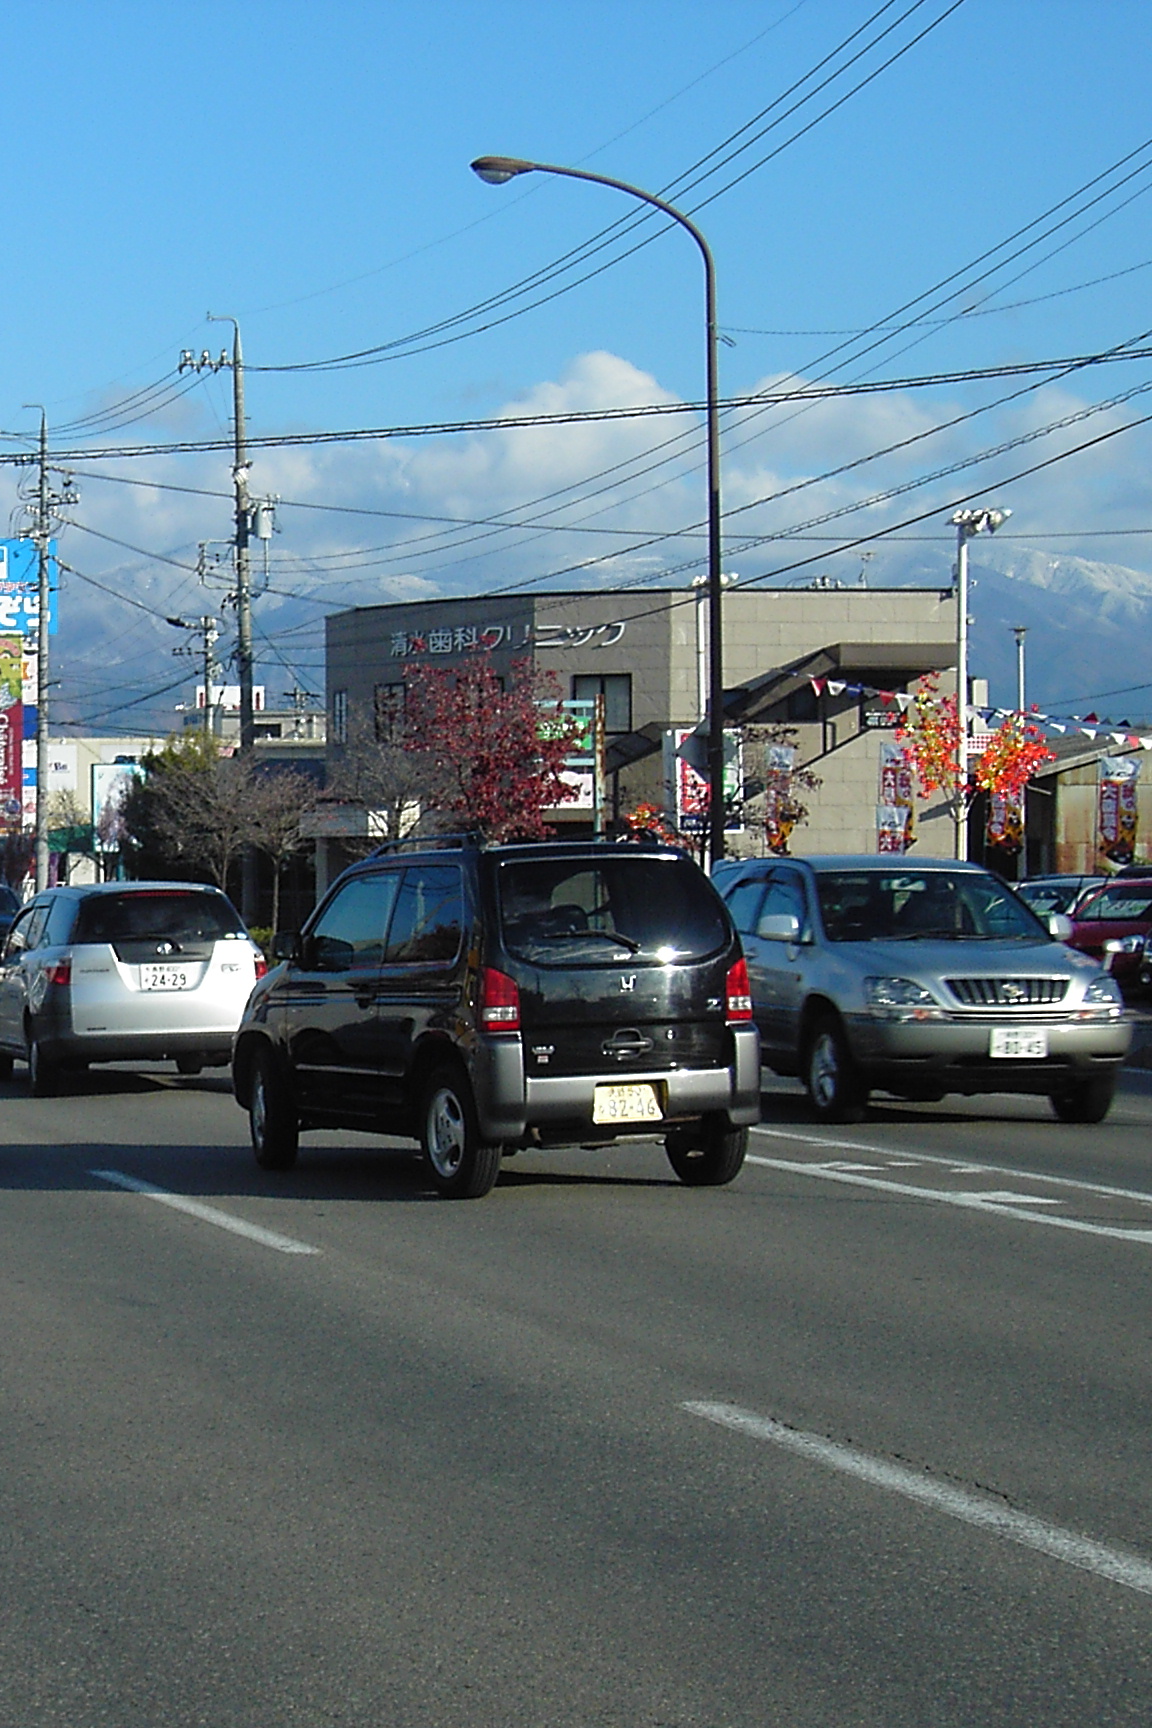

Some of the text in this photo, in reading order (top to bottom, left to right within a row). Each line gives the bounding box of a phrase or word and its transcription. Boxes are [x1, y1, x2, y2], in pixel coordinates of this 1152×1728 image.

[391, 621, 626, 656] 清水歯科クリニック
[152, 973, 187, 986] 24-29
[609, 1099, 655, 1117] 82-46
